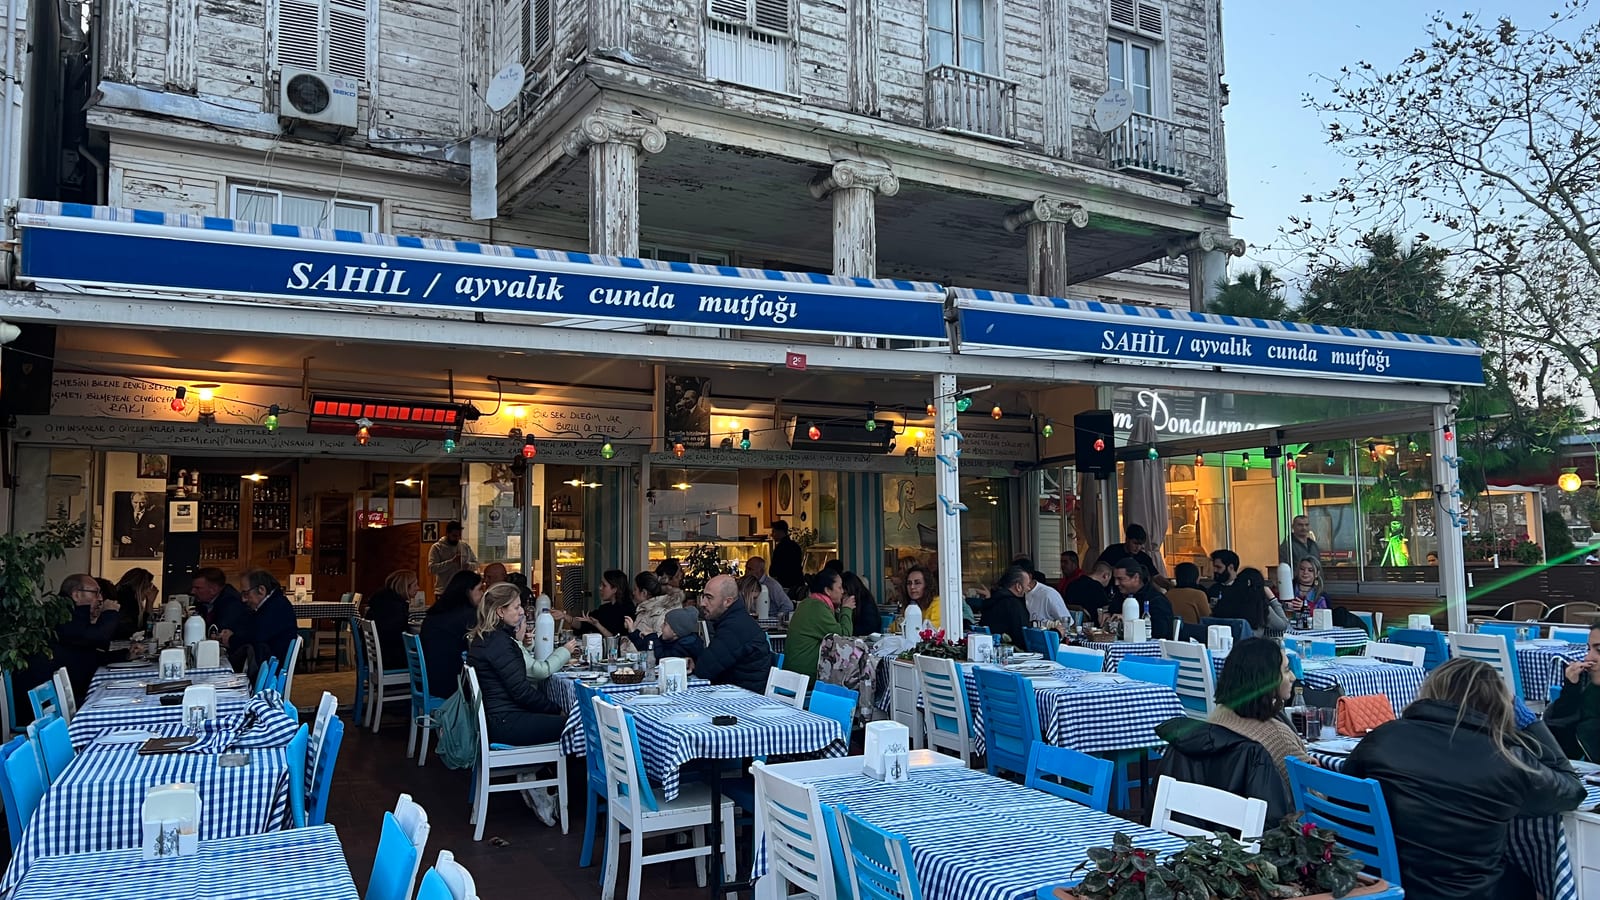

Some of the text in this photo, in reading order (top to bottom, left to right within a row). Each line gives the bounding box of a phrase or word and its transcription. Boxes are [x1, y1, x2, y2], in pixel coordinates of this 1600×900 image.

[286, 262, 798, 323] SAHİL / ayvalık cunda mutfağı
[1101, 329, 1391, 373] SAHİL / ayvalık cunda mutfağı
